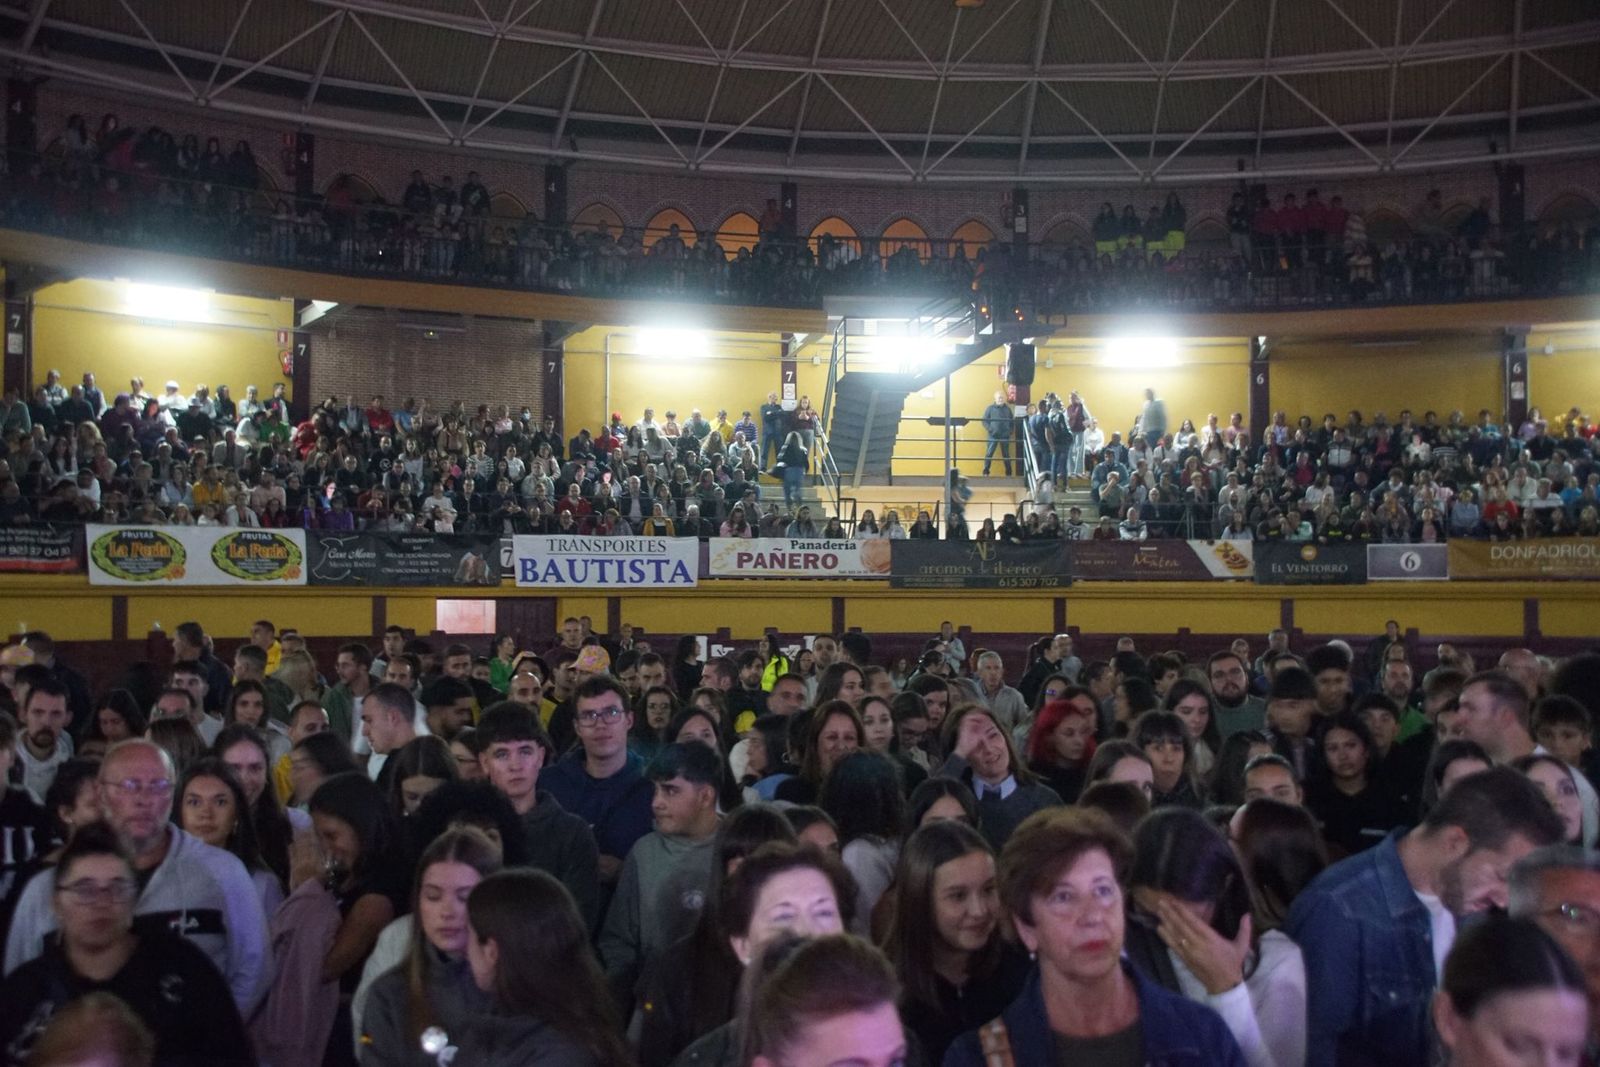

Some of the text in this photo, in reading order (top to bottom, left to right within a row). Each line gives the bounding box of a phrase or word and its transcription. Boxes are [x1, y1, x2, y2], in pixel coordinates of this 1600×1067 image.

[299, 151, 308, 163] 4
[784, 198, 792, 209] 4
[11, 313, 20, 328] 7
[298, 343, 306, 356] 7
[548, 361, 556, 373] 7
[1513, 361, 1521, 374] 6
[785, 371, 793, 382] 7
[1256, 373, 1265, 385] 6
[547, 539, 666, 553] TRANSPORTES
[790, 540, 857, 550] Panadería
[503, 549, 513, 566] 7
[737, 547, 839, 569] PAÑERO
[1404, 552, 1416, 571] 6
[519, 558, 694, 583] BAUTISTA
[920, 564, 973, 575] aromas
[1272, 563, 1349, 574] EL VENTORRO
[1000, 577, 1059, 587] 615 307 702
